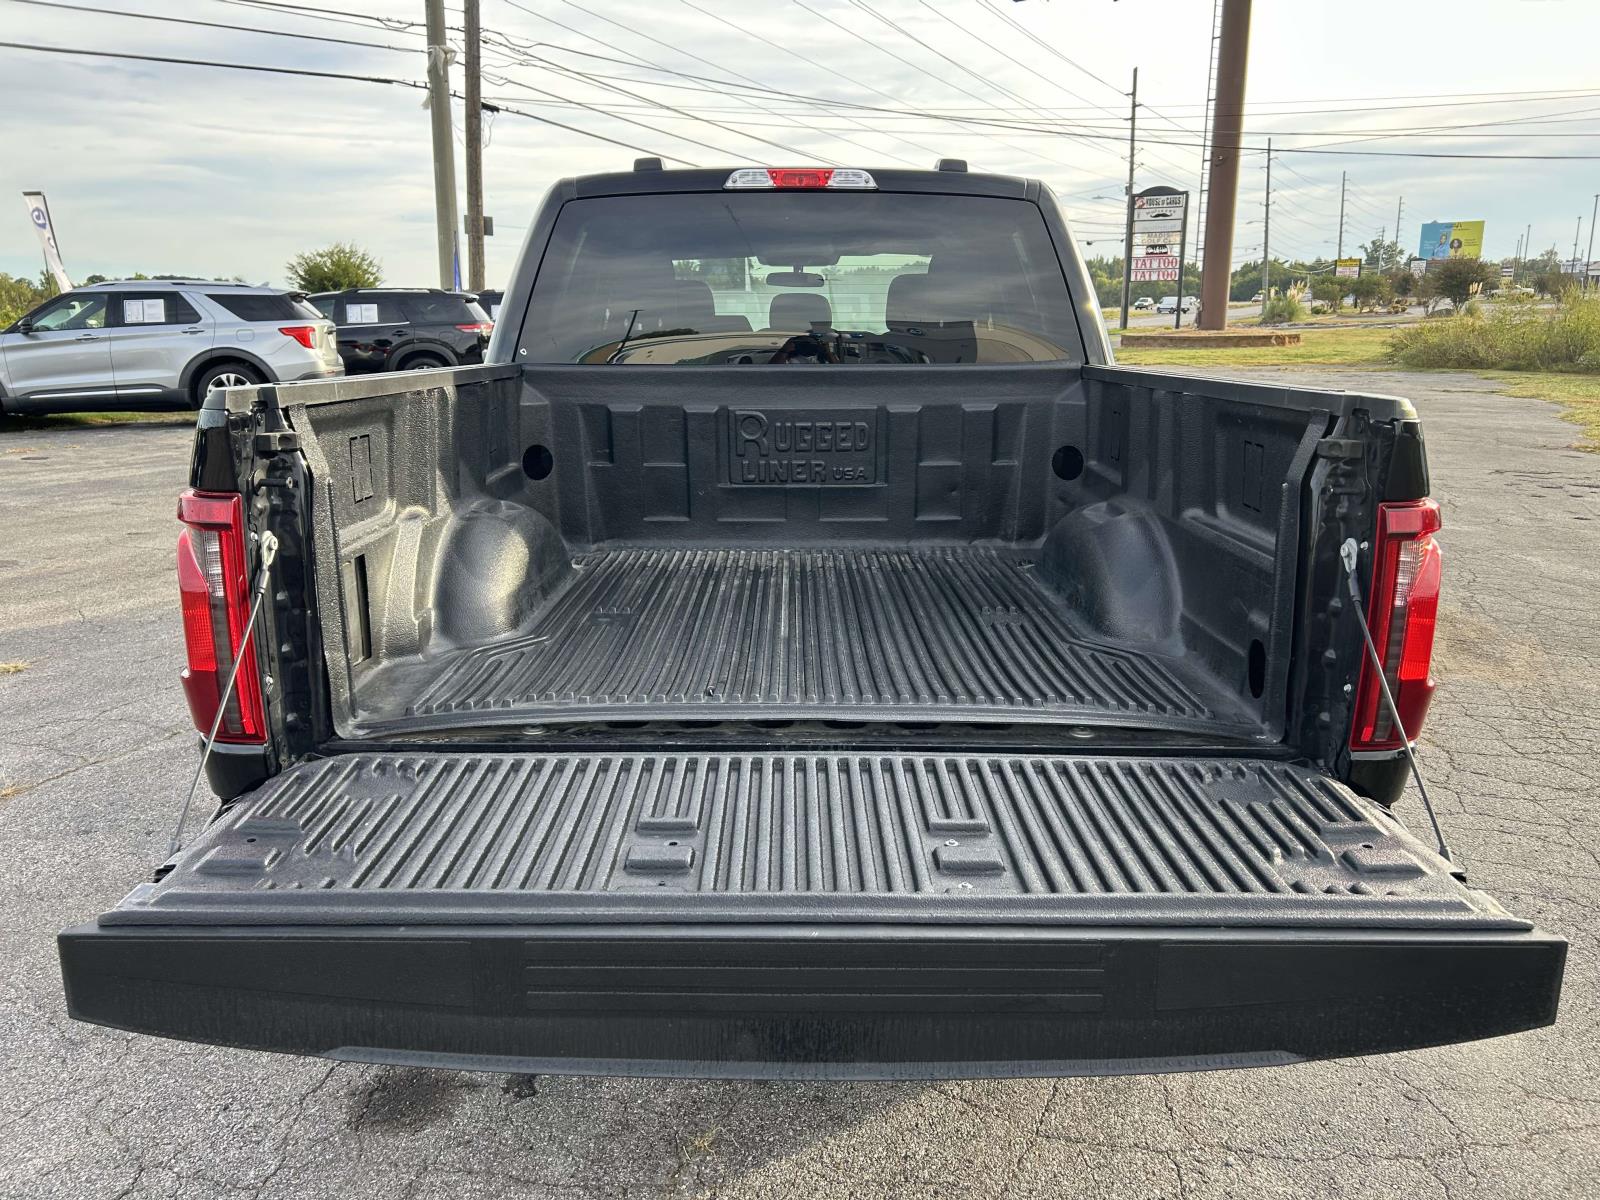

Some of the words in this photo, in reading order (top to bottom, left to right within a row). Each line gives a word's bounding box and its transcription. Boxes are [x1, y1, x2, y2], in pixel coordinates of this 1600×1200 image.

[1133, 257, 1178, 268] TATTOO
[1133, 270, 1177, 281] TATTOO
[734, 410, 870, 457] RUGGED
[741, 459, 827, 483] LINER
[832, 467, 868, 481] USA
